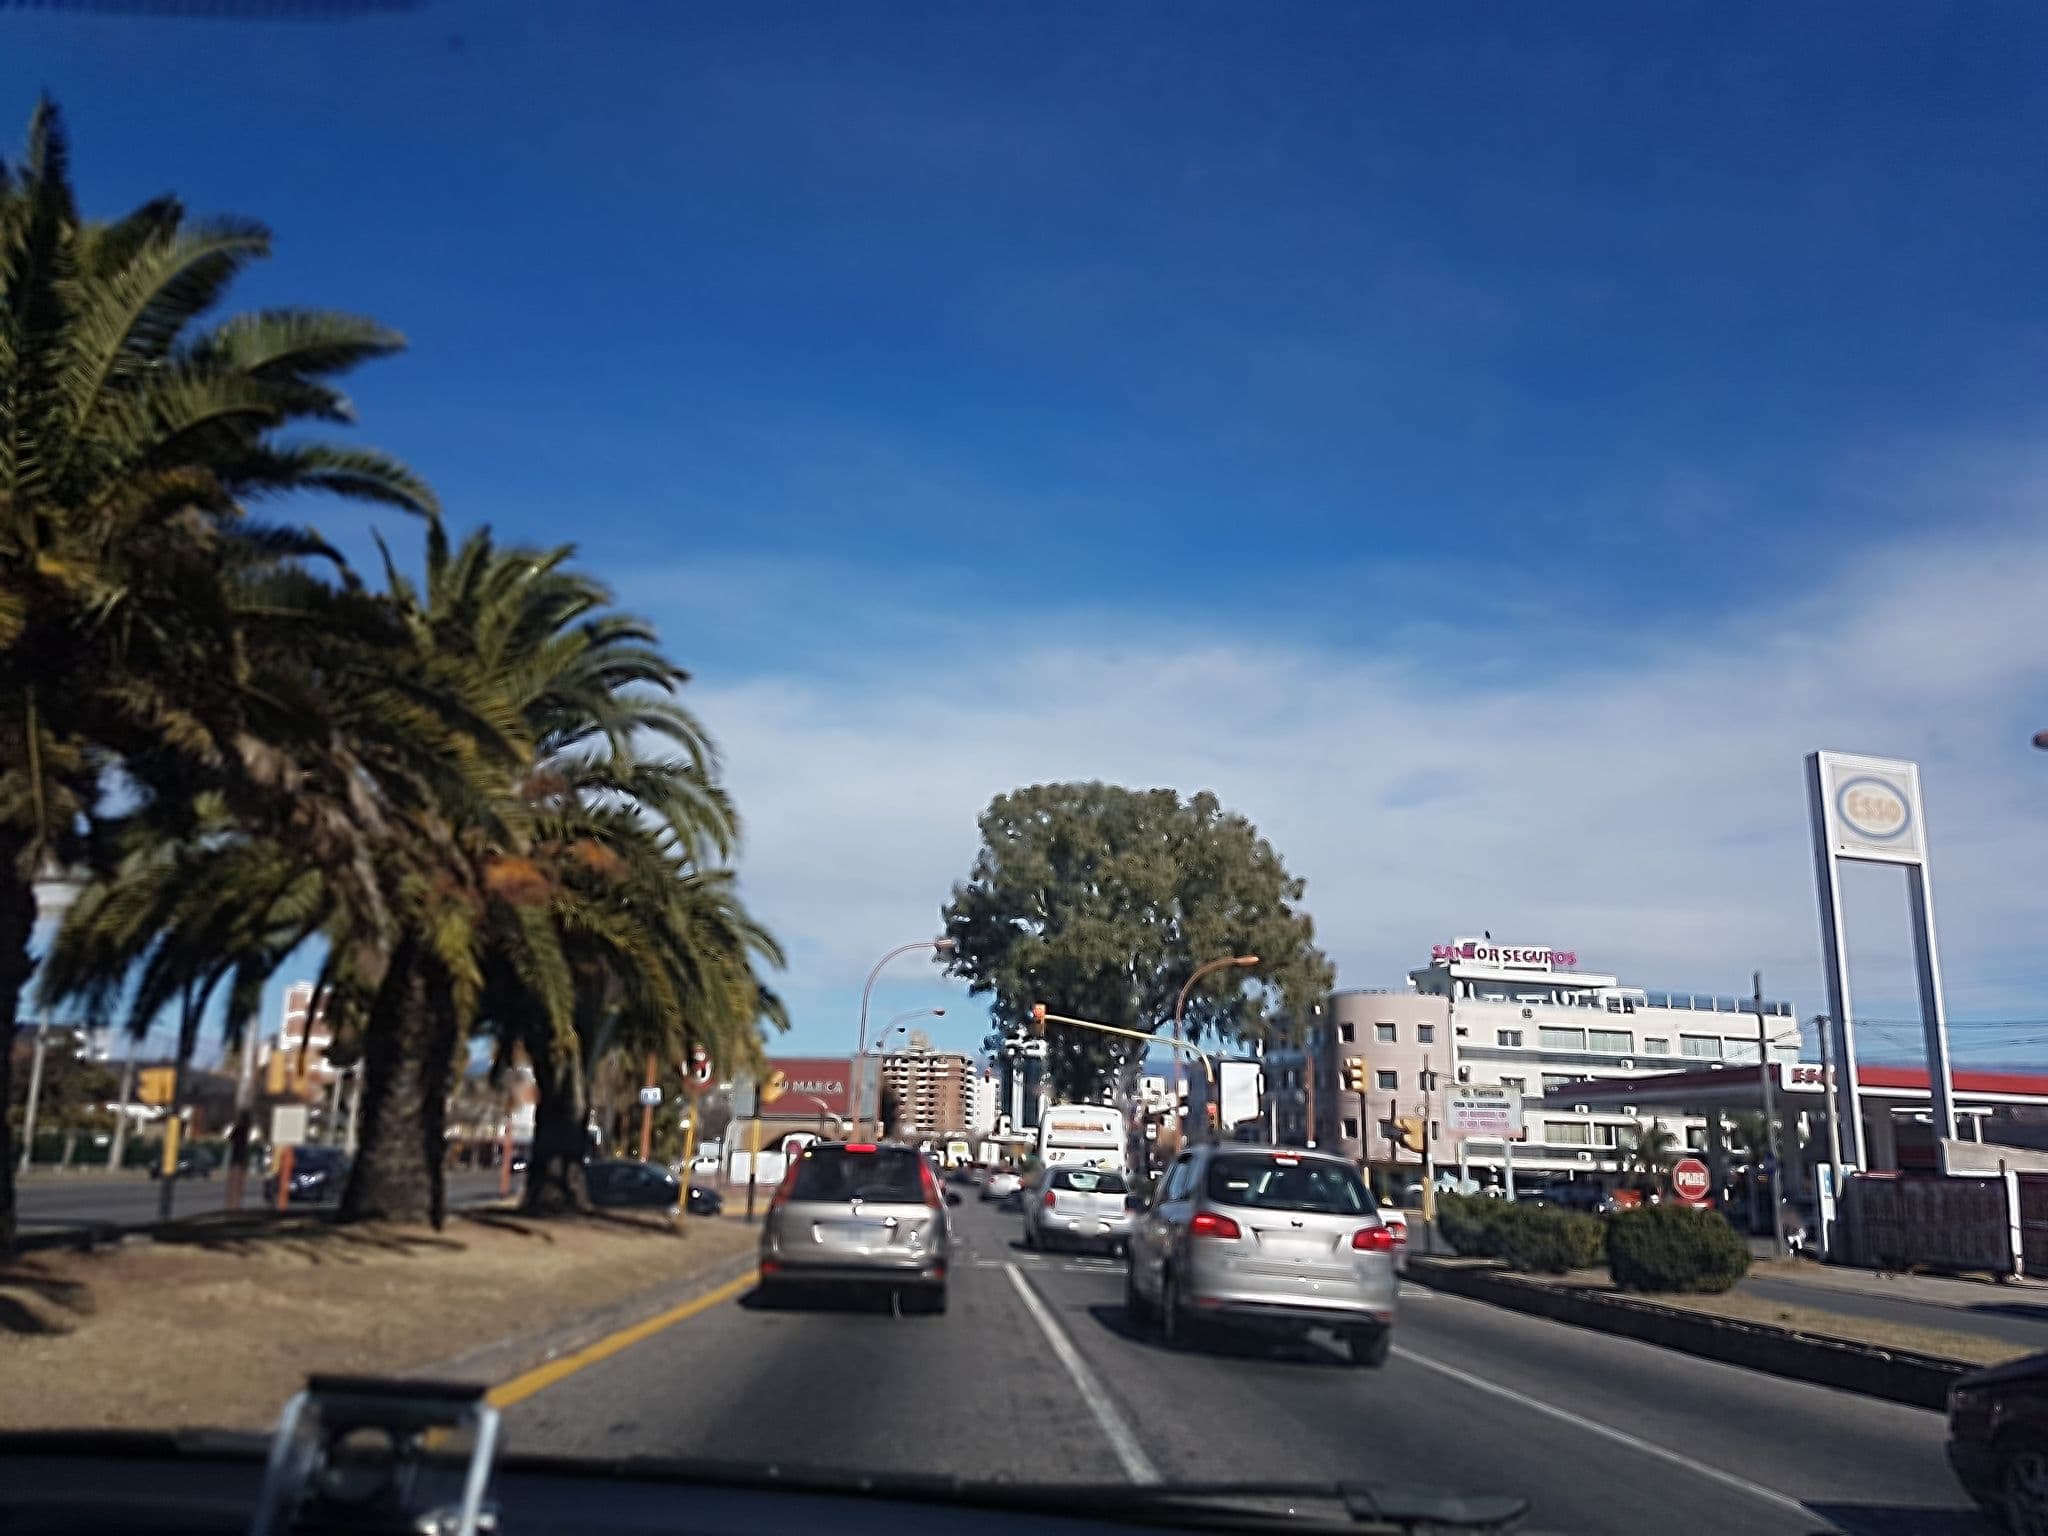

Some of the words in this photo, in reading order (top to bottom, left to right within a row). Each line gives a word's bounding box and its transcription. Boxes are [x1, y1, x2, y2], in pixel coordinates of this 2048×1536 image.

[1503, 948, 1577, 966] SEGUROS
[792, 1081, 843, 1094] MARCA
[1677, 1171, 1706, 1186] PARE
